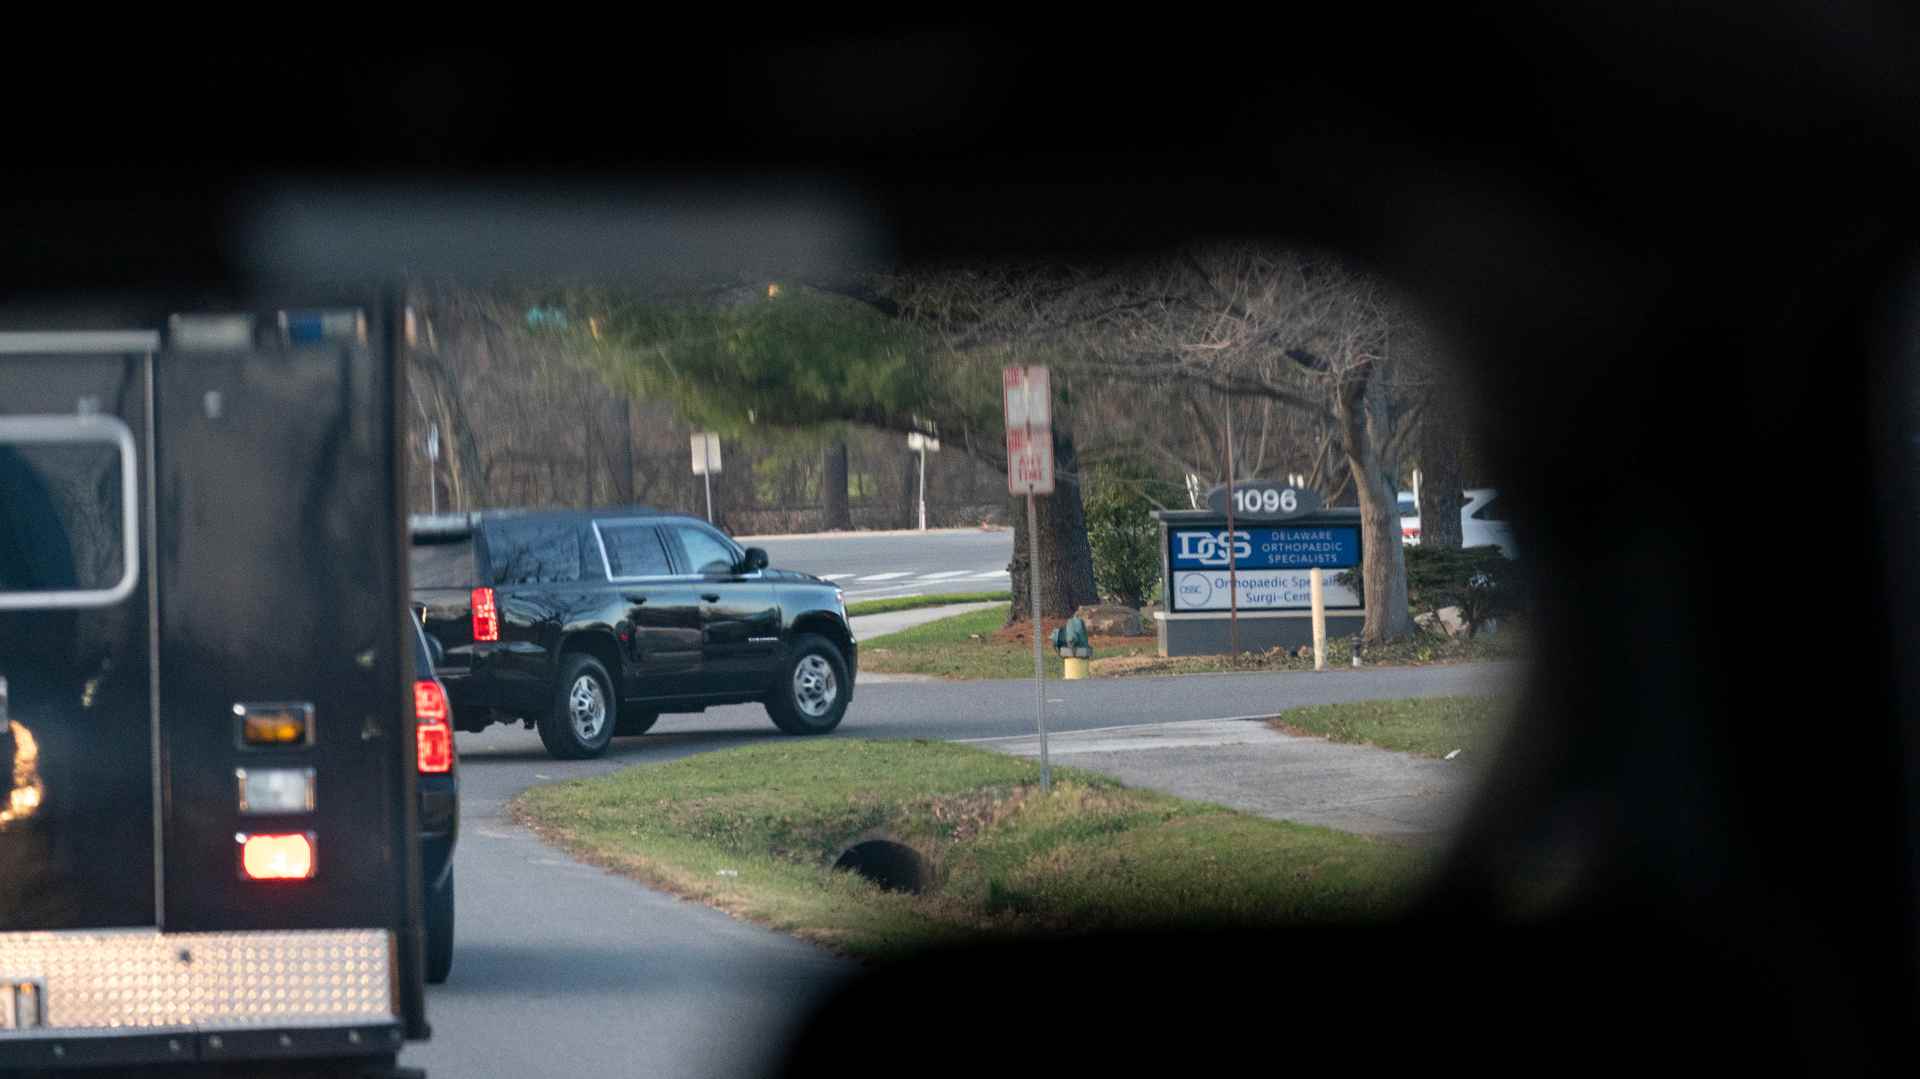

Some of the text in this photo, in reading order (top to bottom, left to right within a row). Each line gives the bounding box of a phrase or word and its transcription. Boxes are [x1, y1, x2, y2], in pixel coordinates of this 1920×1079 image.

[1233, 488, 1297, 513] 1096
[1271, 531, 1332, 541] DELAWARE
[1261, 542, 1343, 553] ORTHOPAEDIC
[1268, 553, 1337, 565] SPECIALISTS
[1214, 577, 1289, 590] Orhopaedic
[1246, 592, 1314, 605] Surgi-Cent
